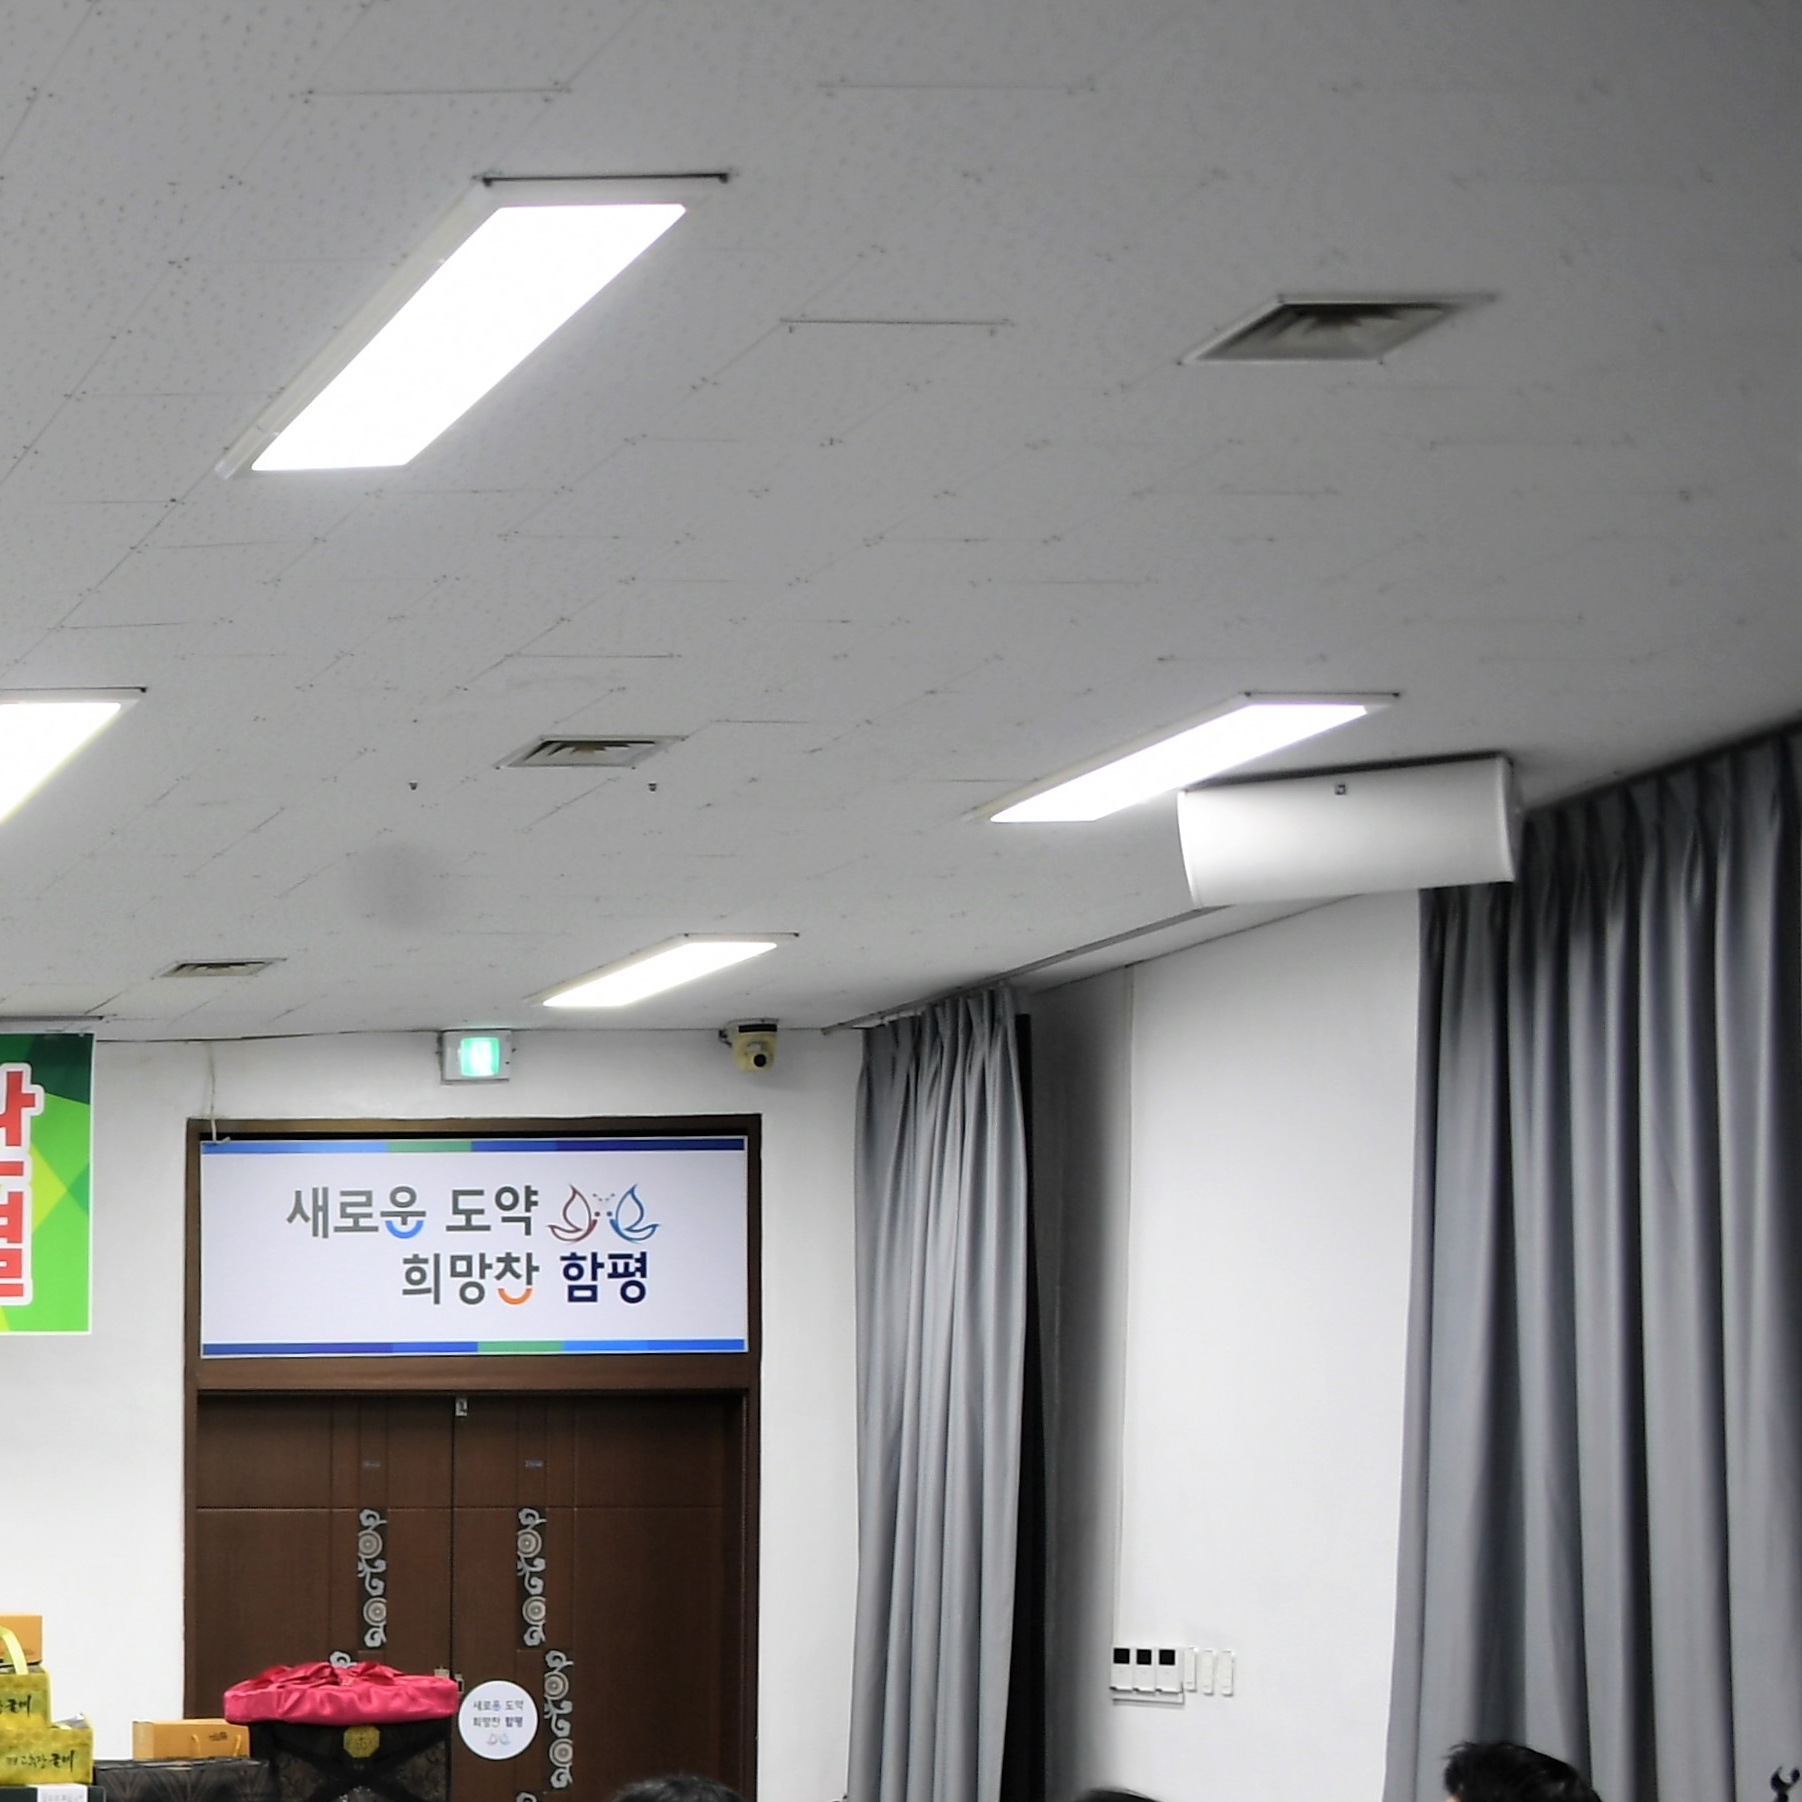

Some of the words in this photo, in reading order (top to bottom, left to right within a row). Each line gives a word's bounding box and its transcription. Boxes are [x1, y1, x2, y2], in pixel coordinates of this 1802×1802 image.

[287, 1186, 426, 1239] 새로운
[446, 1185, 538, 1236] 도약
[403, 1252, 539, 1305] 희망찬
[560, 1252, 646, 1303] 함평
